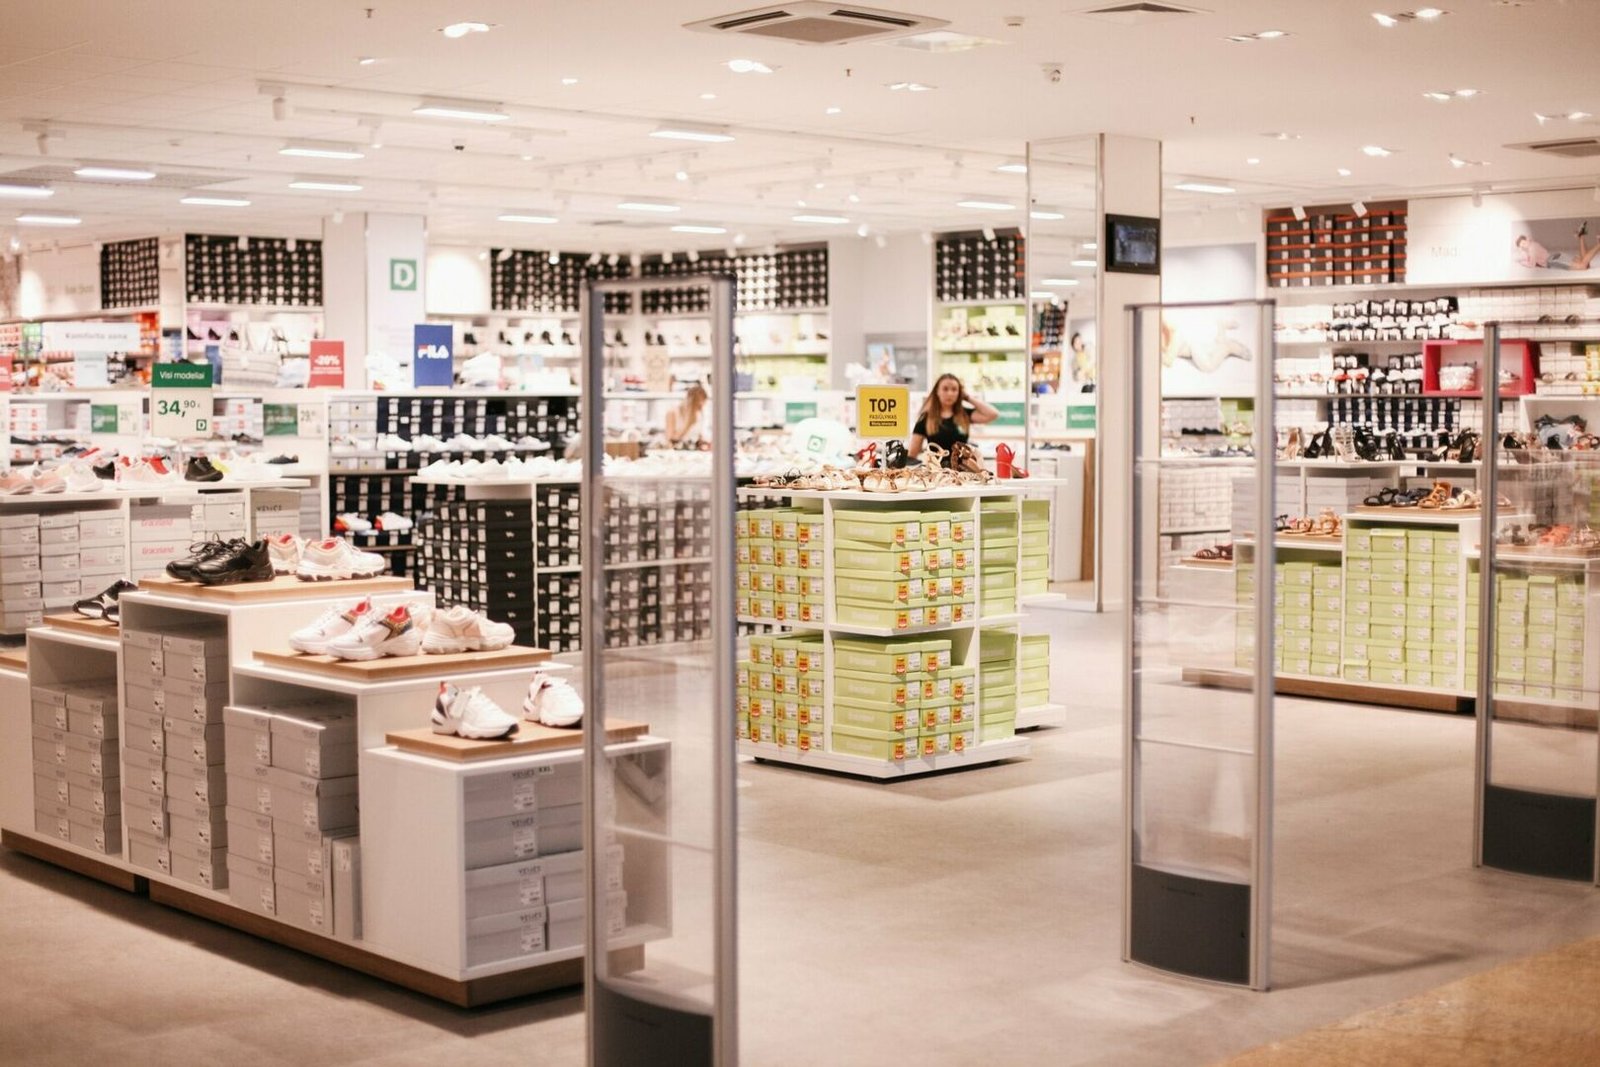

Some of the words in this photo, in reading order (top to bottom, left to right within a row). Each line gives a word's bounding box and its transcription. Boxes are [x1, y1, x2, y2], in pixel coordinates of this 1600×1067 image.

[392, 261, 415, 288] D
[417, 344, 450, 360] FILA
[159, 370, 174, 380] Visi
[173, 370, 206, 380] modeliai
[868, 398, 897, 412] TOP
